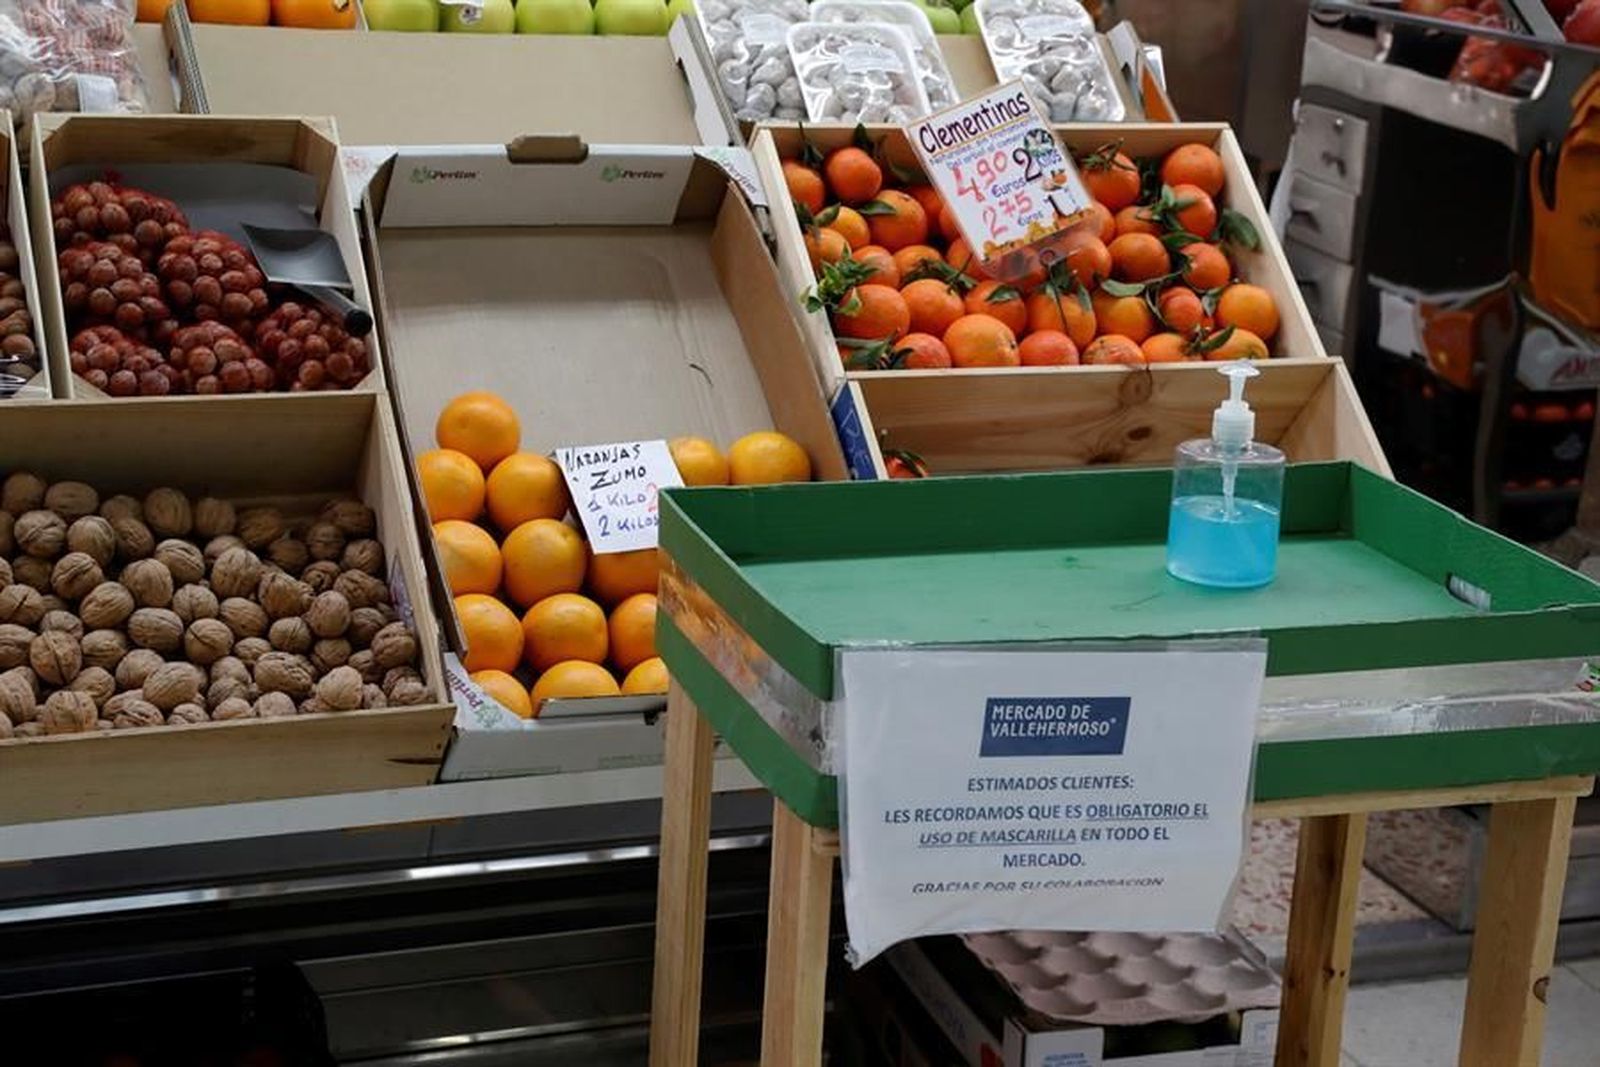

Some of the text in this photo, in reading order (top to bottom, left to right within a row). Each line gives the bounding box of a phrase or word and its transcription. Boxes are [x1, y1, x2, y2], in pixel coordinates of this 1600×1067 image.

[920, 92, 1030, 153] Clementinas
[1013, 148, 1042, 181] 2
[564, 444, 641, 472] NARANJAS
[590, 466, 647, 491] ZUMO
[607, 492, 647, 507] KILO
[598, 515, 610, 537] 2
[992, 704, 1091, 720] MERCADO DE
[990, 721, 1110, 737] VALLEHERMOSO
[968, 775, 1134, 792] ESTIMADOS CLIENTES:
[885, 803, 1209, 824] LES RECORDAMOS QUE ES OBLIGATORIO EL
[920, 826, 1170, 845] USO DE MASCARILLA EN TODO EL
[1003, 853, 1086, 868] MERCADO.
[912, 881, 980, 894] GRACIAS
[983, 881, 1016, 892] POR
[1020, 880, 1042, 891] SU
